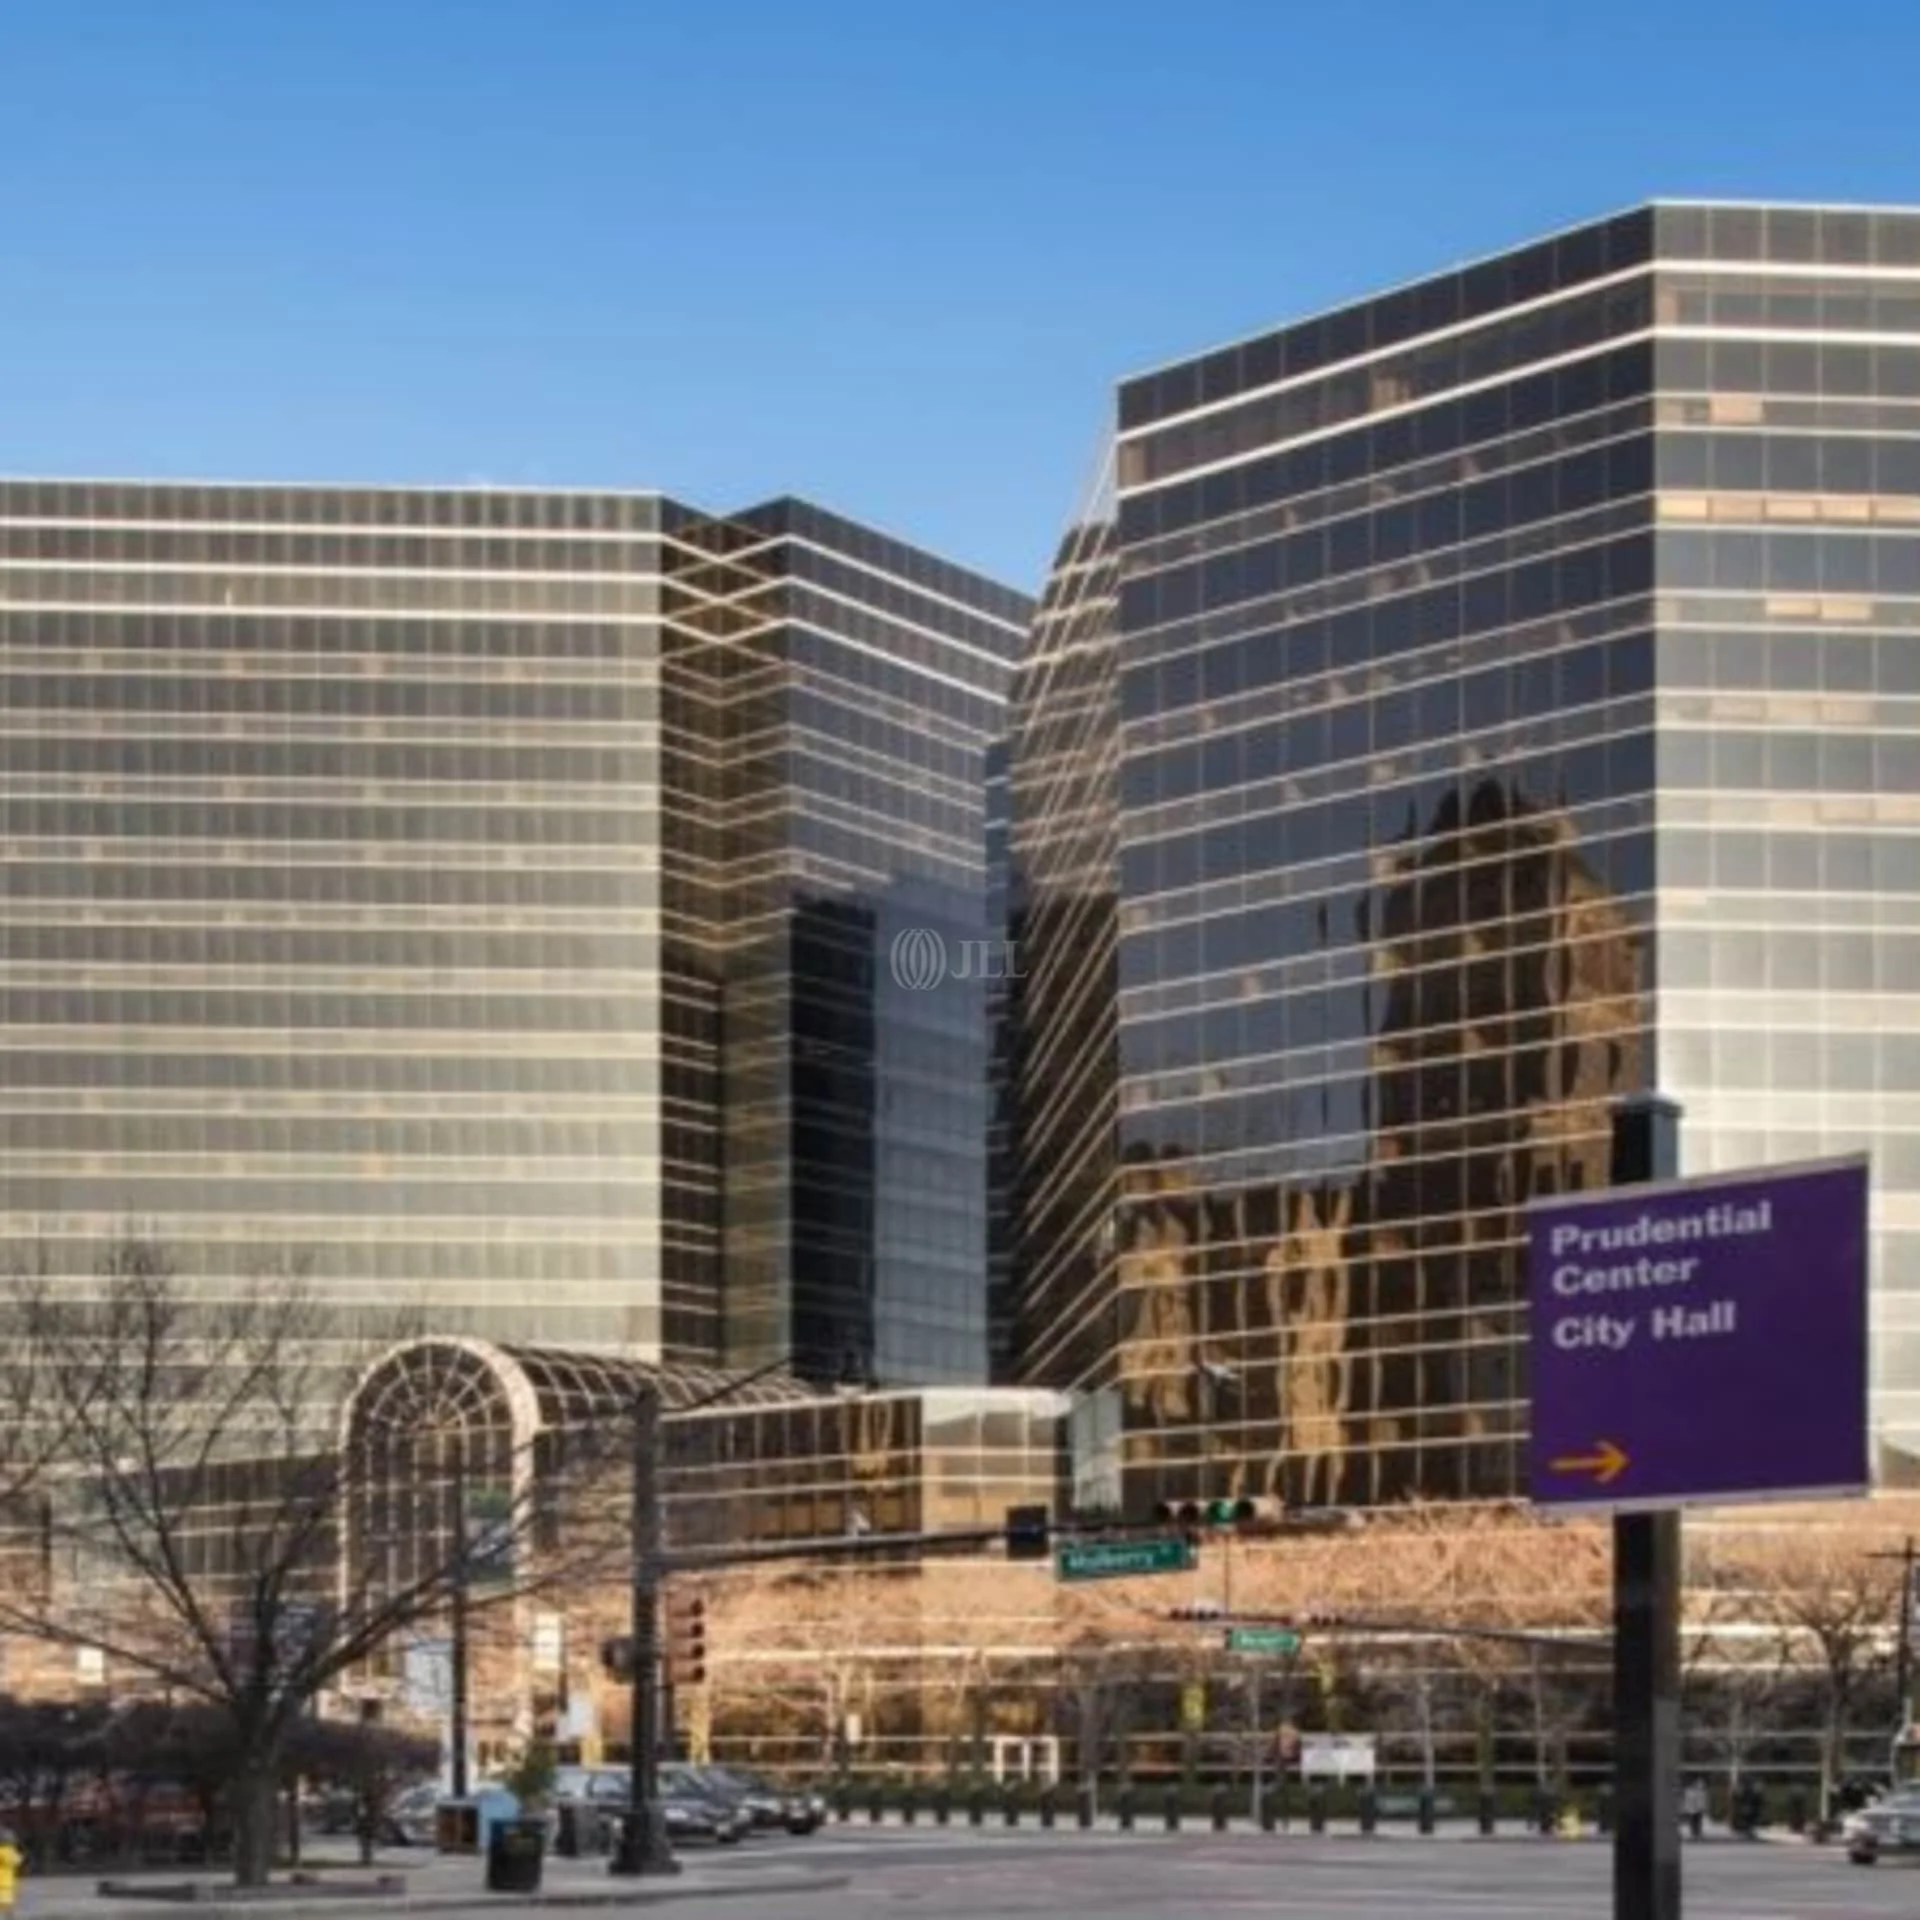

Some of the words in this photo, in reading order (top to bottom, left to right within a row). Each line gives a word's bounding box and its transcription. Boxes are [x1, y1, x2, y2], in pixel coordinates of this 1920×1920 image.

[1551, 1201, 1772, 1256] Prudential
[1552, 1258, 1699, 1295] Center
[1553, 1315, 1635, 1350] City
[1652, 1301, 1736, 1338] Hall
